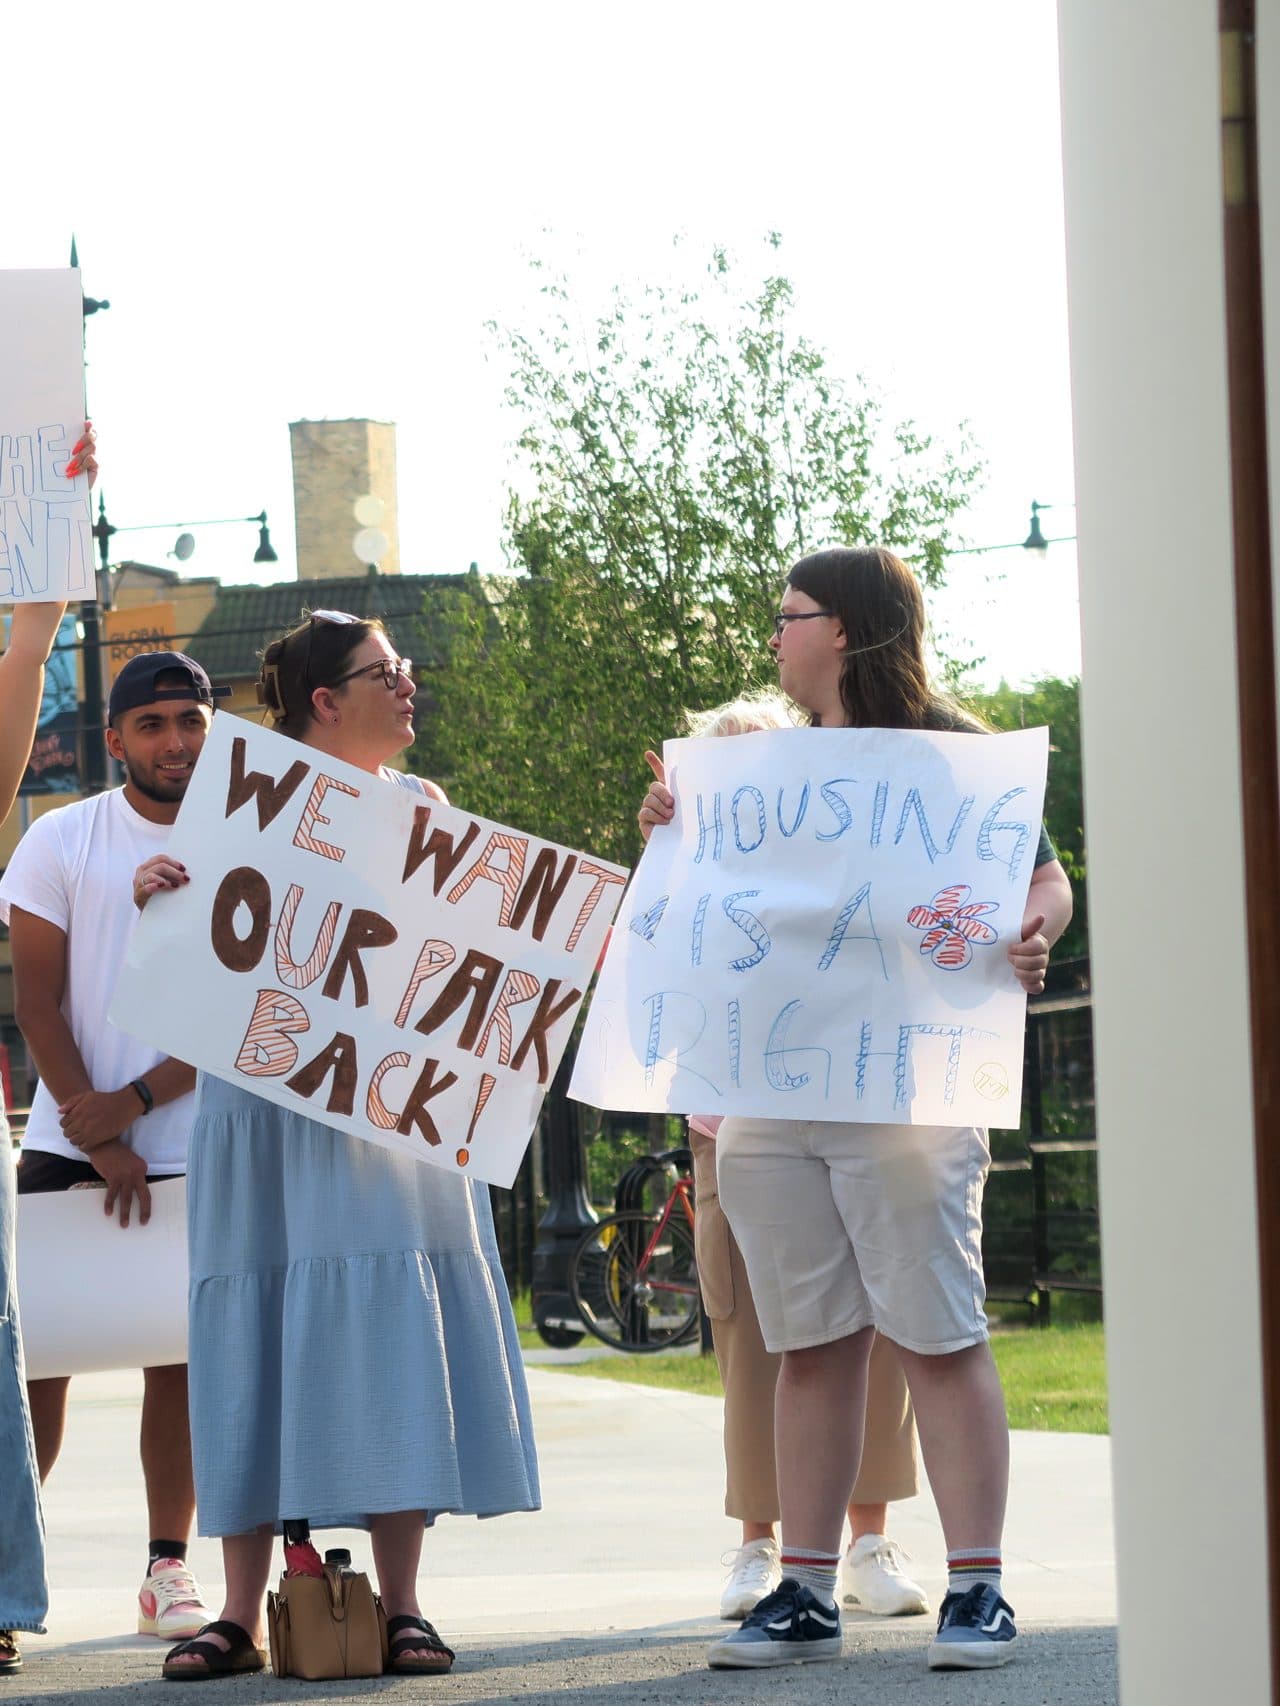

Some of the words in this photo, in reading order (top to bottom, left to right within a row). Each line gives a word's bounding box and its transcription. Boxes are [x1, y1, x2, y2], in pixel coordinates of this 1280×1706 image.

[225, 738, 360, 863] WE
[402, 805, 626, 952] WANT
[694, 779, 1030, 882] HOUSING
[211, 866, 398, 1008] OUR
[394, 939, 581, 1085] PARK
[691, 890, 772, 972] IS
[817, 881, 888, 980] A
[234, 989, 495, 1167] BACK!
[642, 992, 1000, 1110] RIGHT
